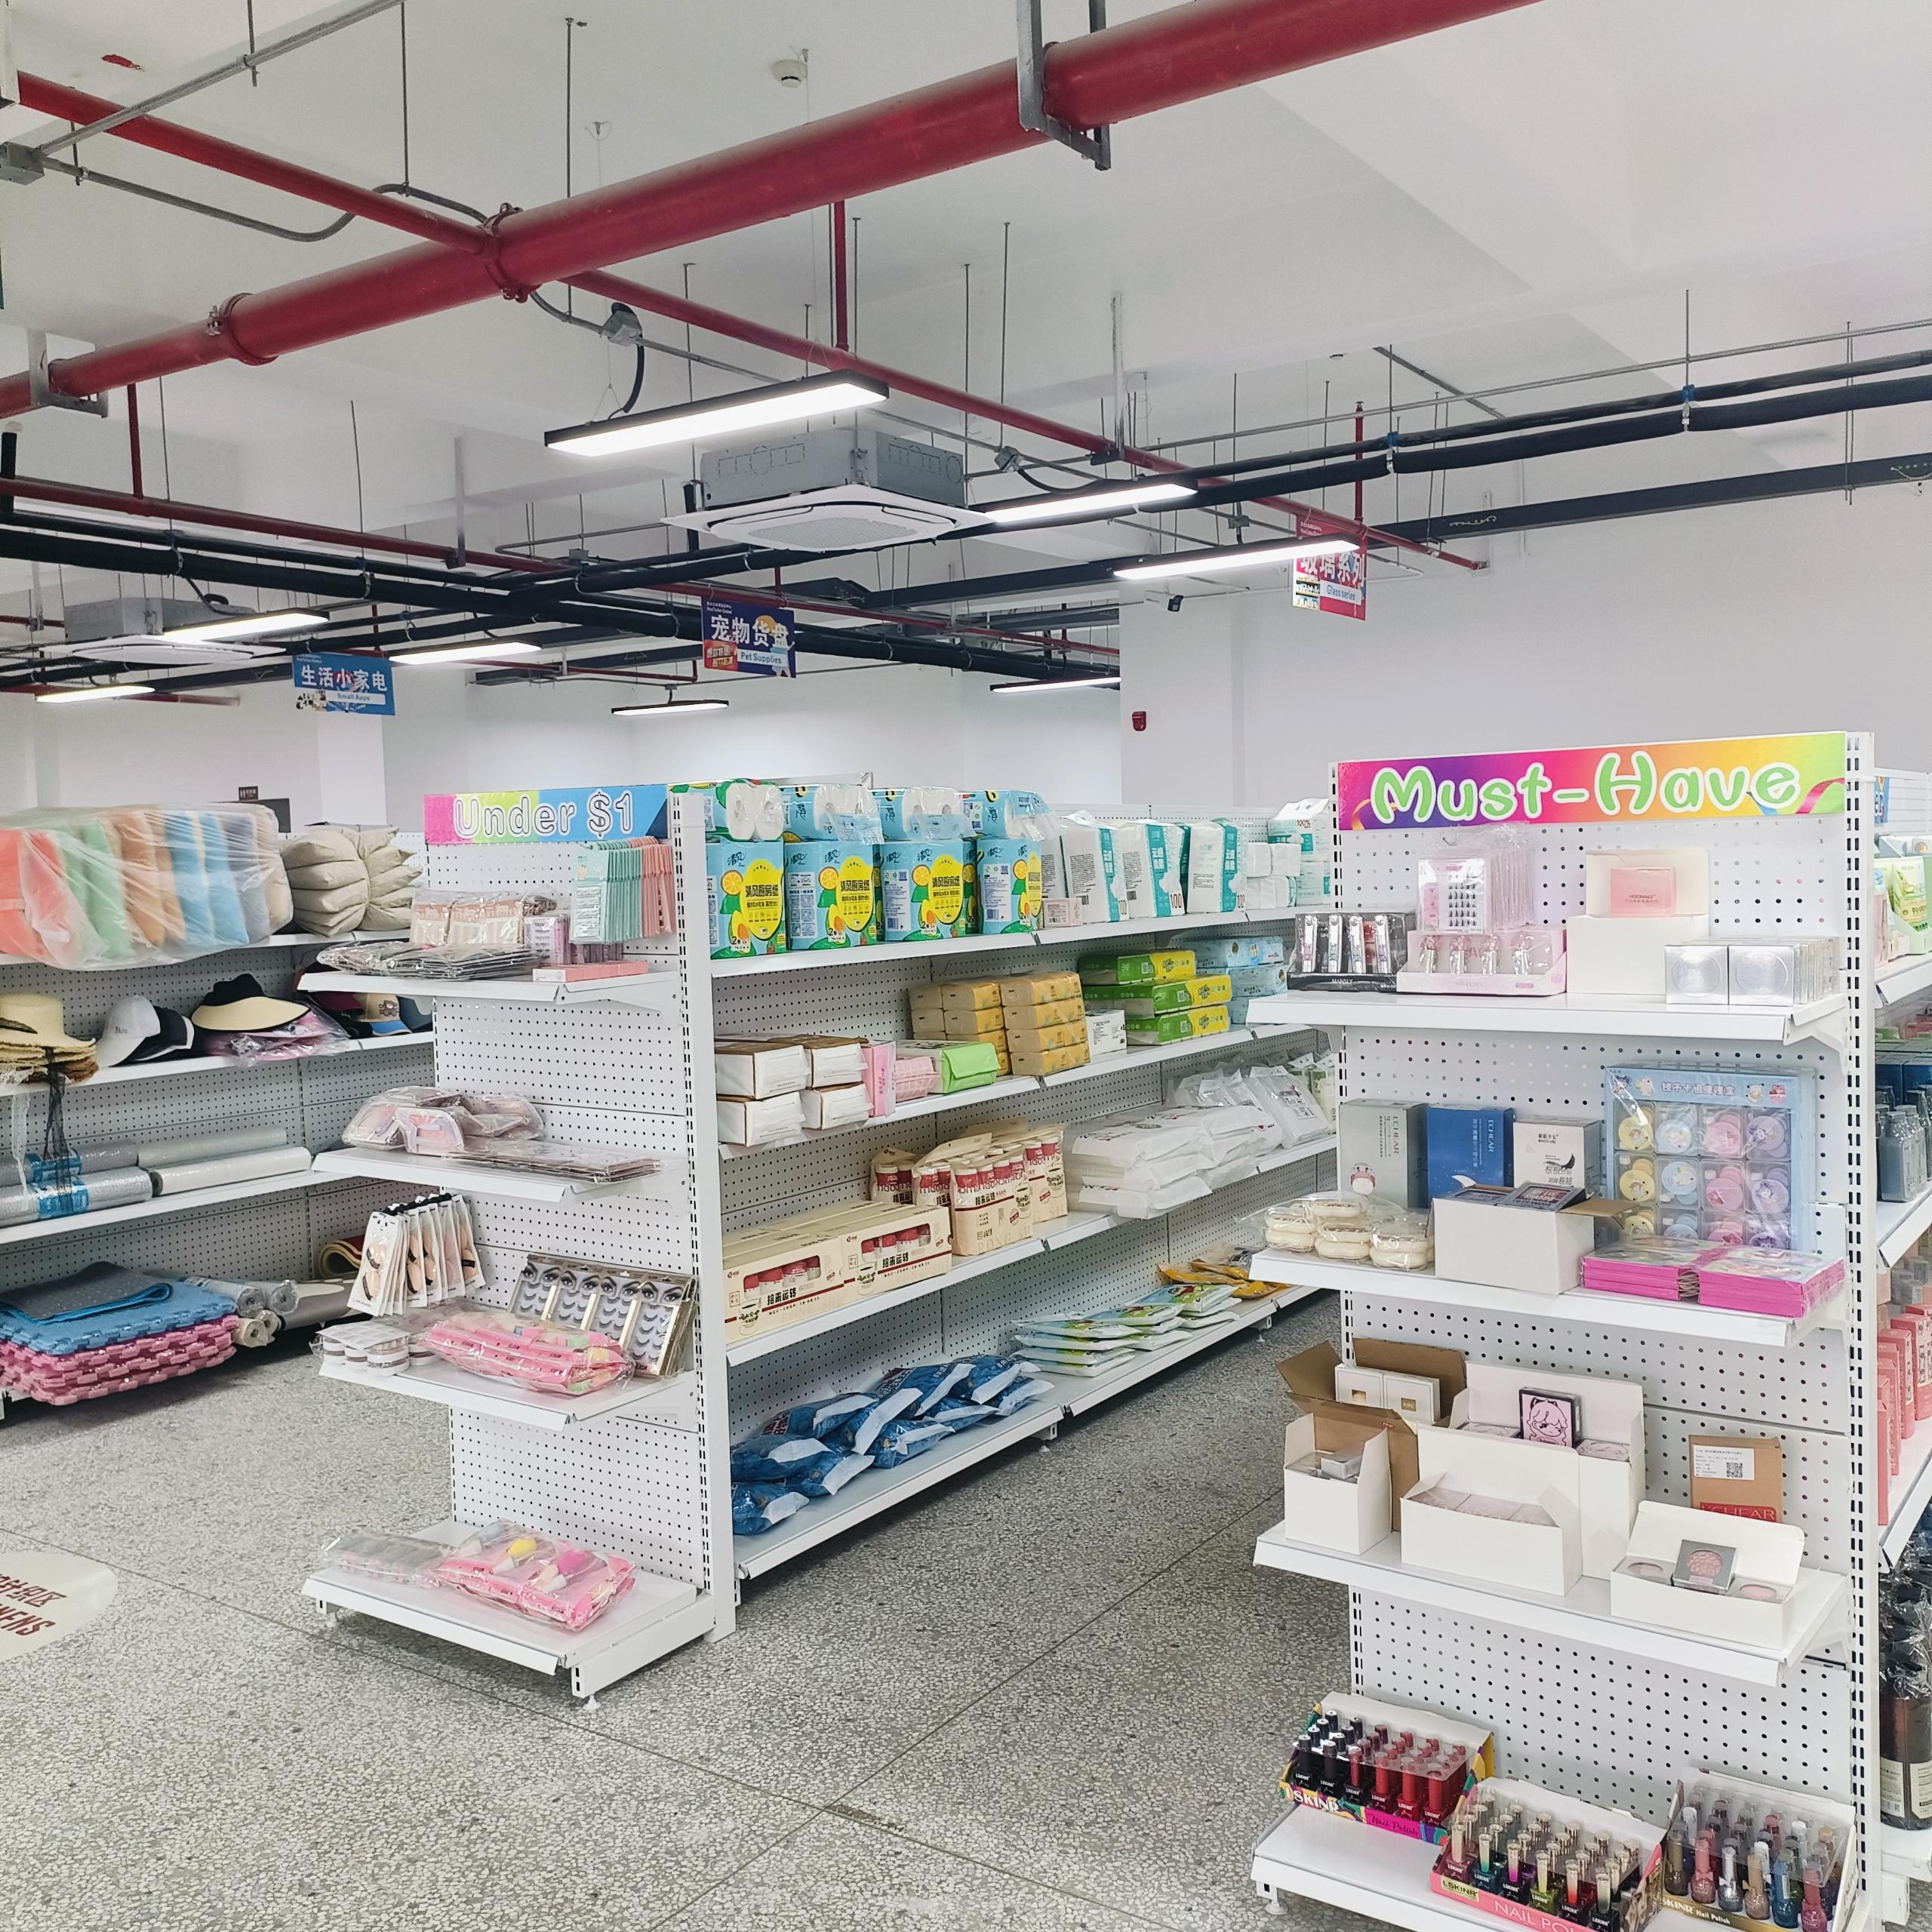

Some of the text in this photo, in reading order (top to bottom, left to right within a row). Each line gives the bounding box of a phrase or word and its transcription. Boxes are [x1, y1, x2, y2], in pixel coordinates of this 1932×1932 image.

[1327, 584, 1356, 601] Glass series
[741, 651, 752, 661] Pet
[754, 654, 782, 664] Supplies
[301, 664, 387, 692] 生活小家电
[1370, 749, 1800, 825] Must-Have
[454, 789, 632, 839] Under $1
[1170, 894, 1182, 909] 100
[1442, 1880, 1478, 1898] LSKINR
[1494, 1900, 1536, 1925] NAIL
[1661, 1898, 1731, 1925] SKINR Nail Polish
